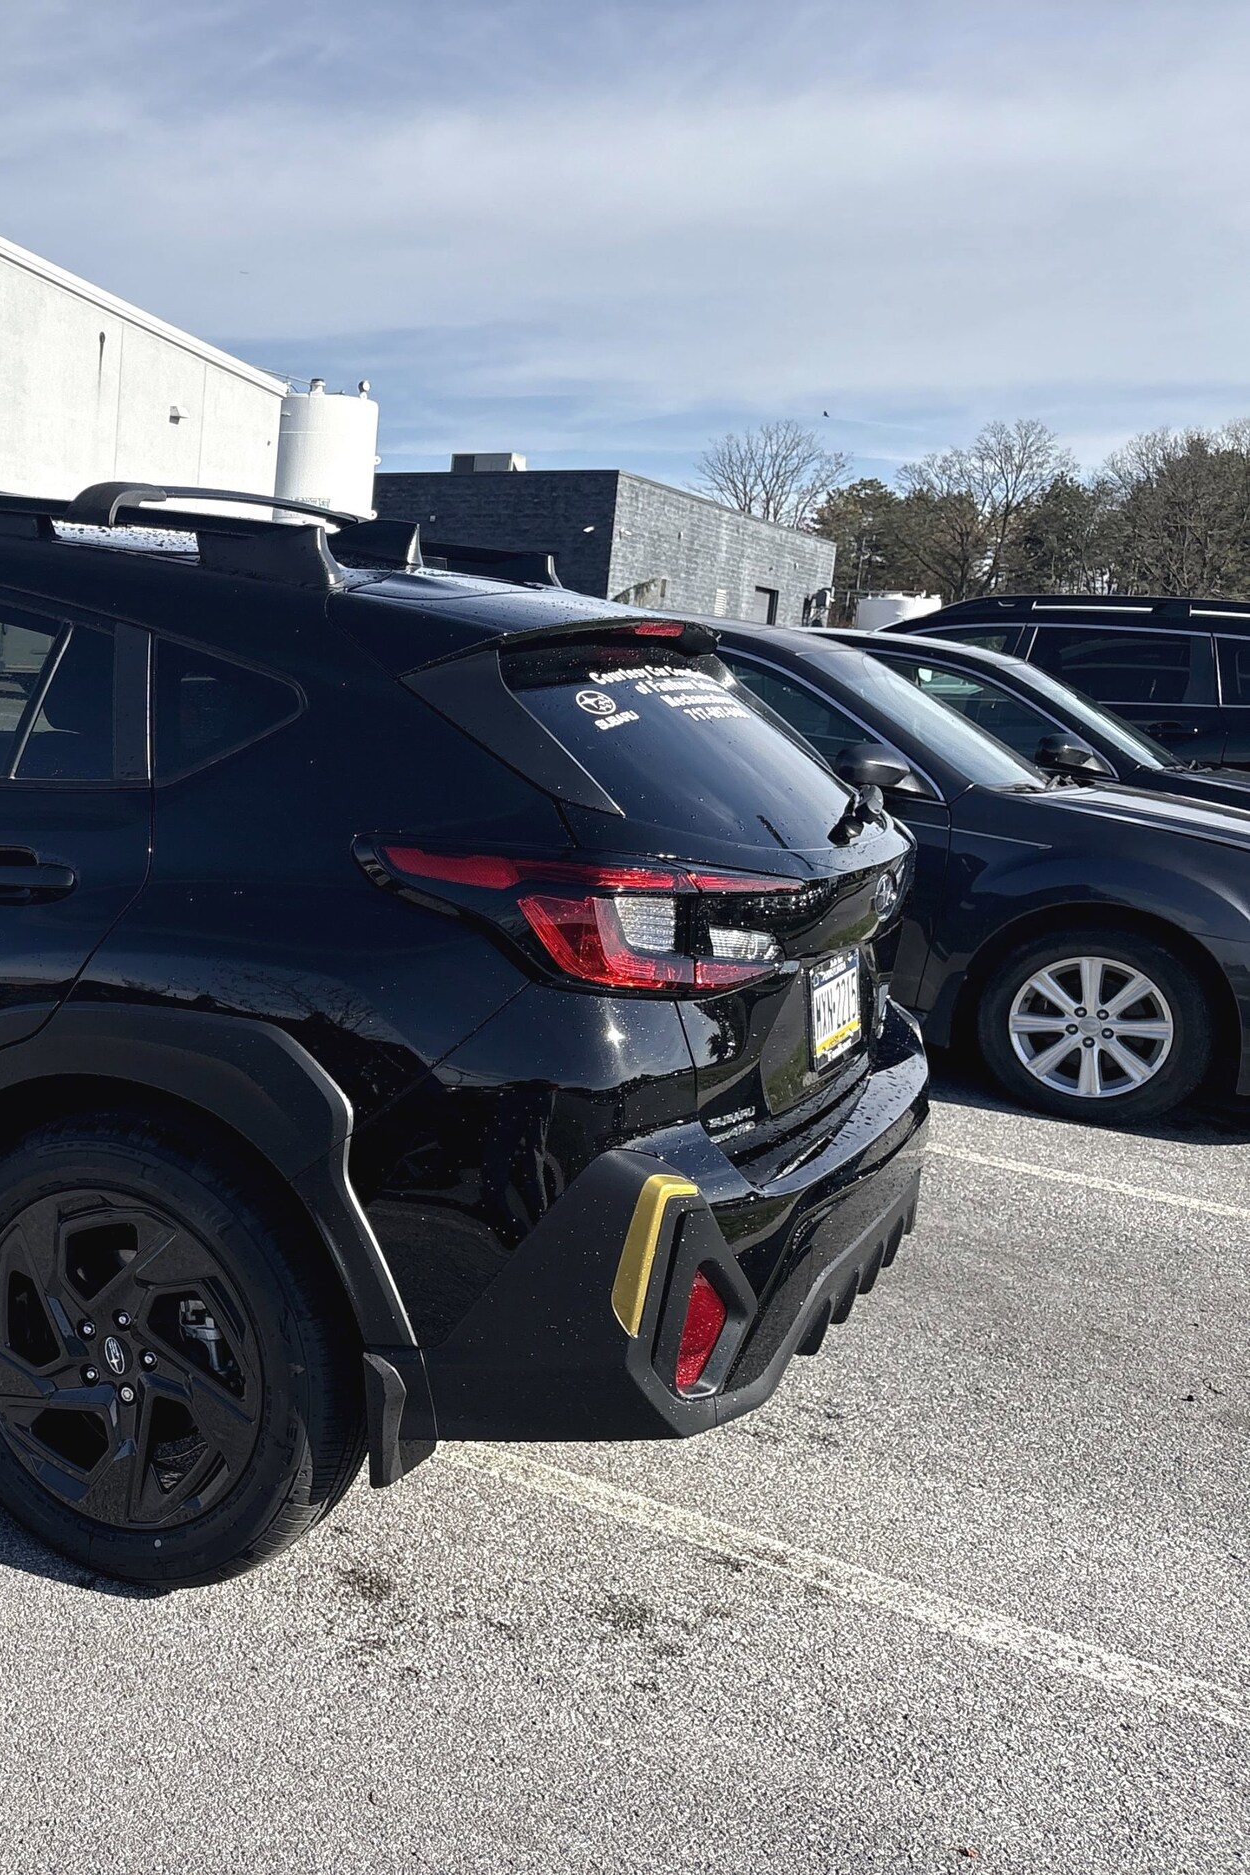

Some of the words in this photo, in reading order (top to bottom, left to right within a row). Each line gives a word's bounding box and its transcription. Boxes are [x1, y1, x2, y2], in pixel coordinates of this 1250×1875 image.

[588, 666, 653, 685] Courtesy
[645, 664, 666, 678] Car
[634, 681, 653, 695] of
[594, 709, 640, 730] SUBARU
